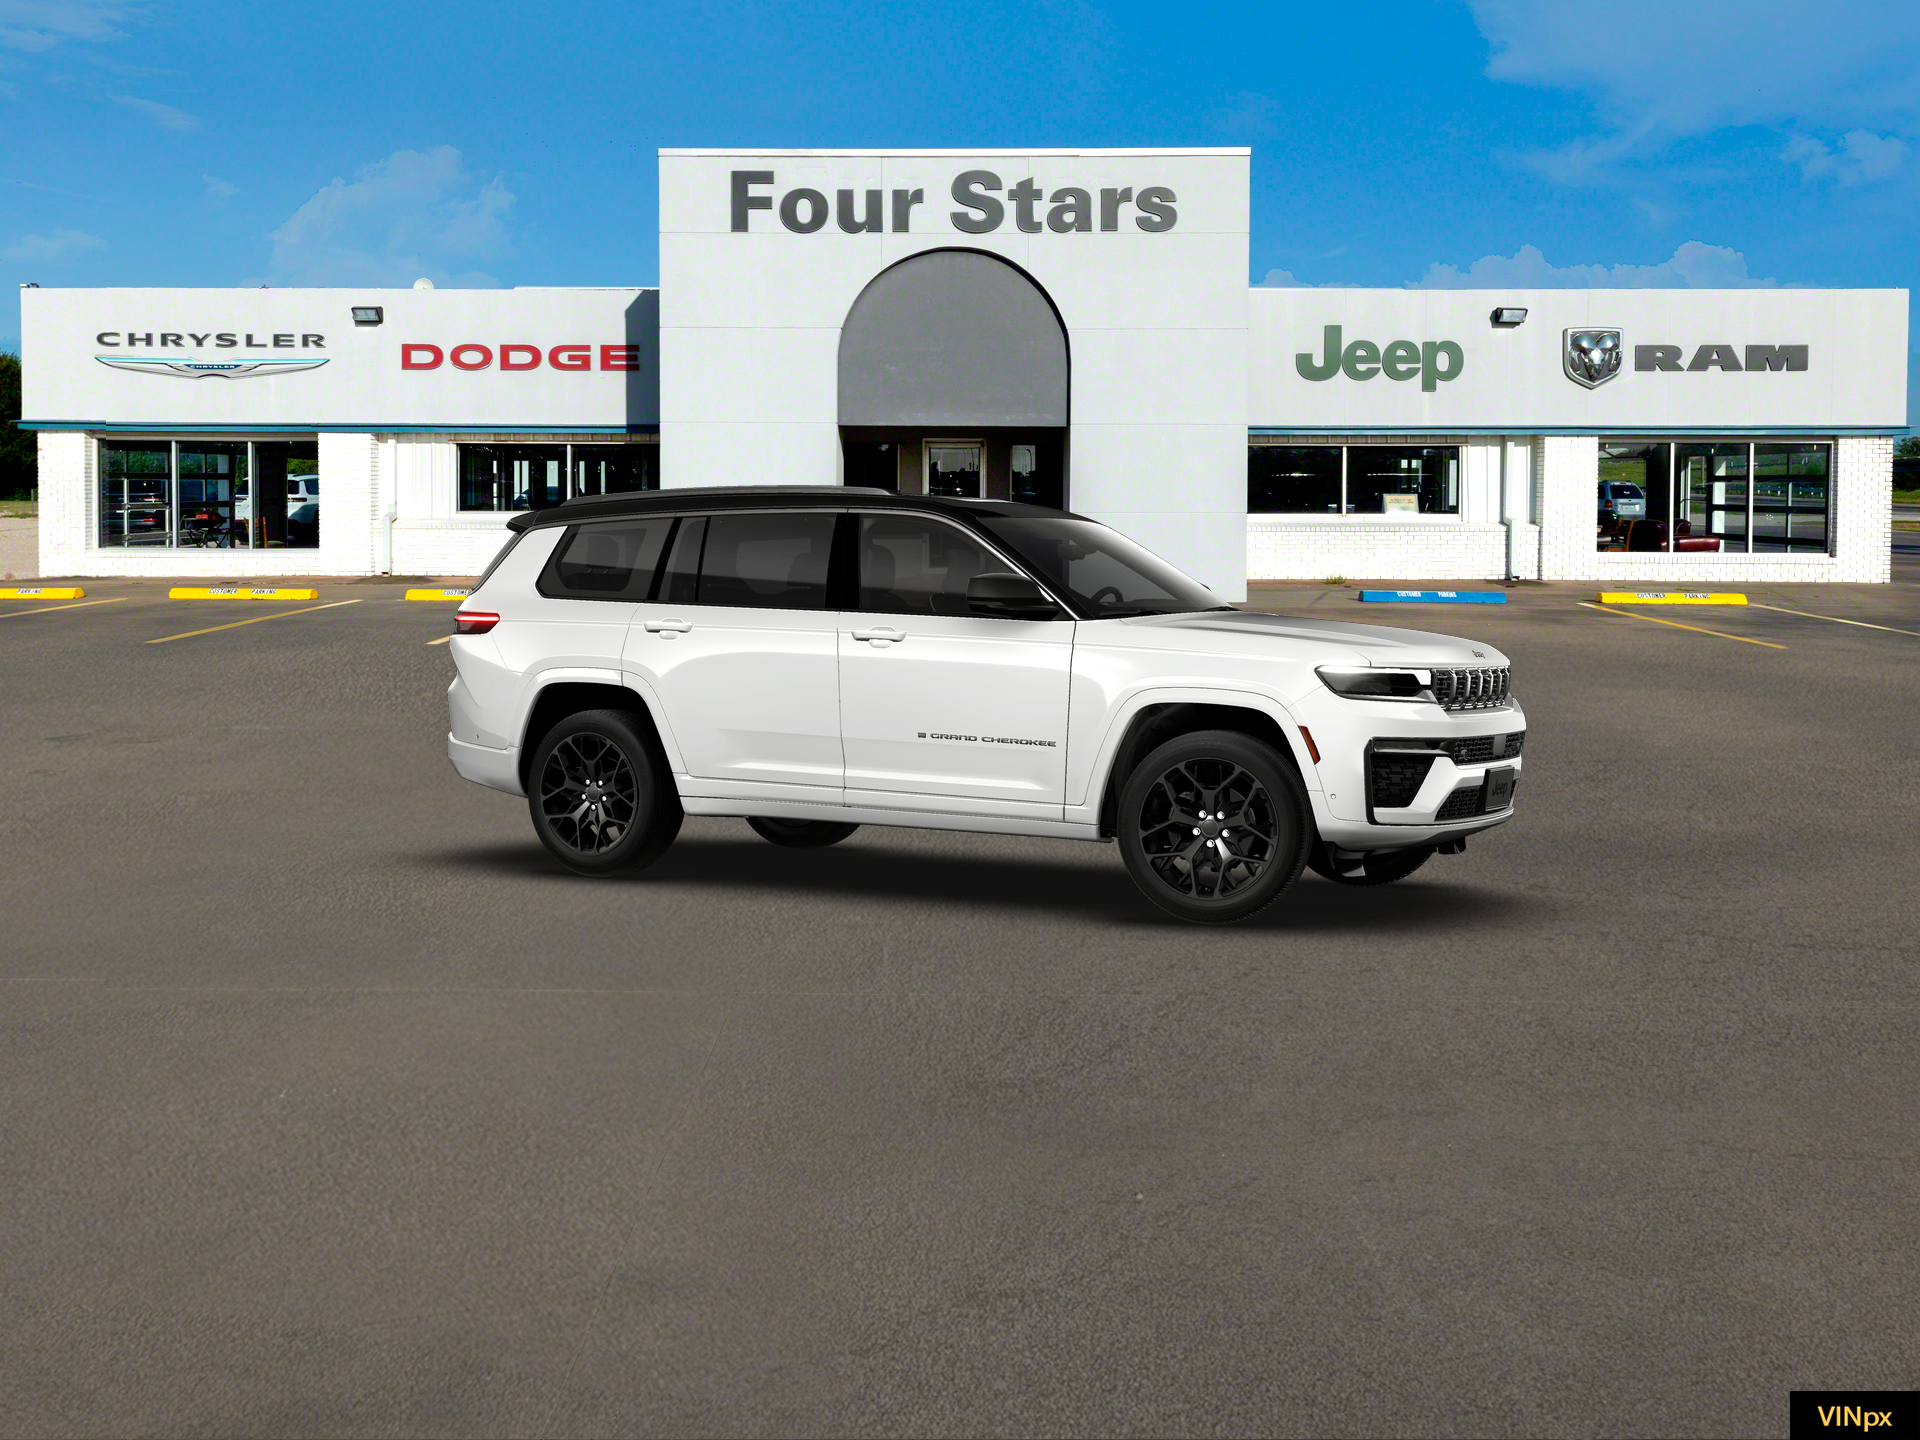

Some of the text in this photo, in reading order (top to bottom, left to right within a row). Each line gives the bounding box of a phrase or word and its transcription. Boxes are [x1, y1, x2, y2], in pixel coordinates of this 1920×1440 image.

[730, 169, 1178, 234] Four Stars
[96, 332, 326, 348] CHRYSLER
[401, 343, 640, 371] DODGE
[1295, 324, 1465, 392] Jeep
[1634, 344, 1809, 371] RAM
[930, 733, 1057, 747] GRAND CHEROKEE
[1491, 778, 1509, 798] Jeep
